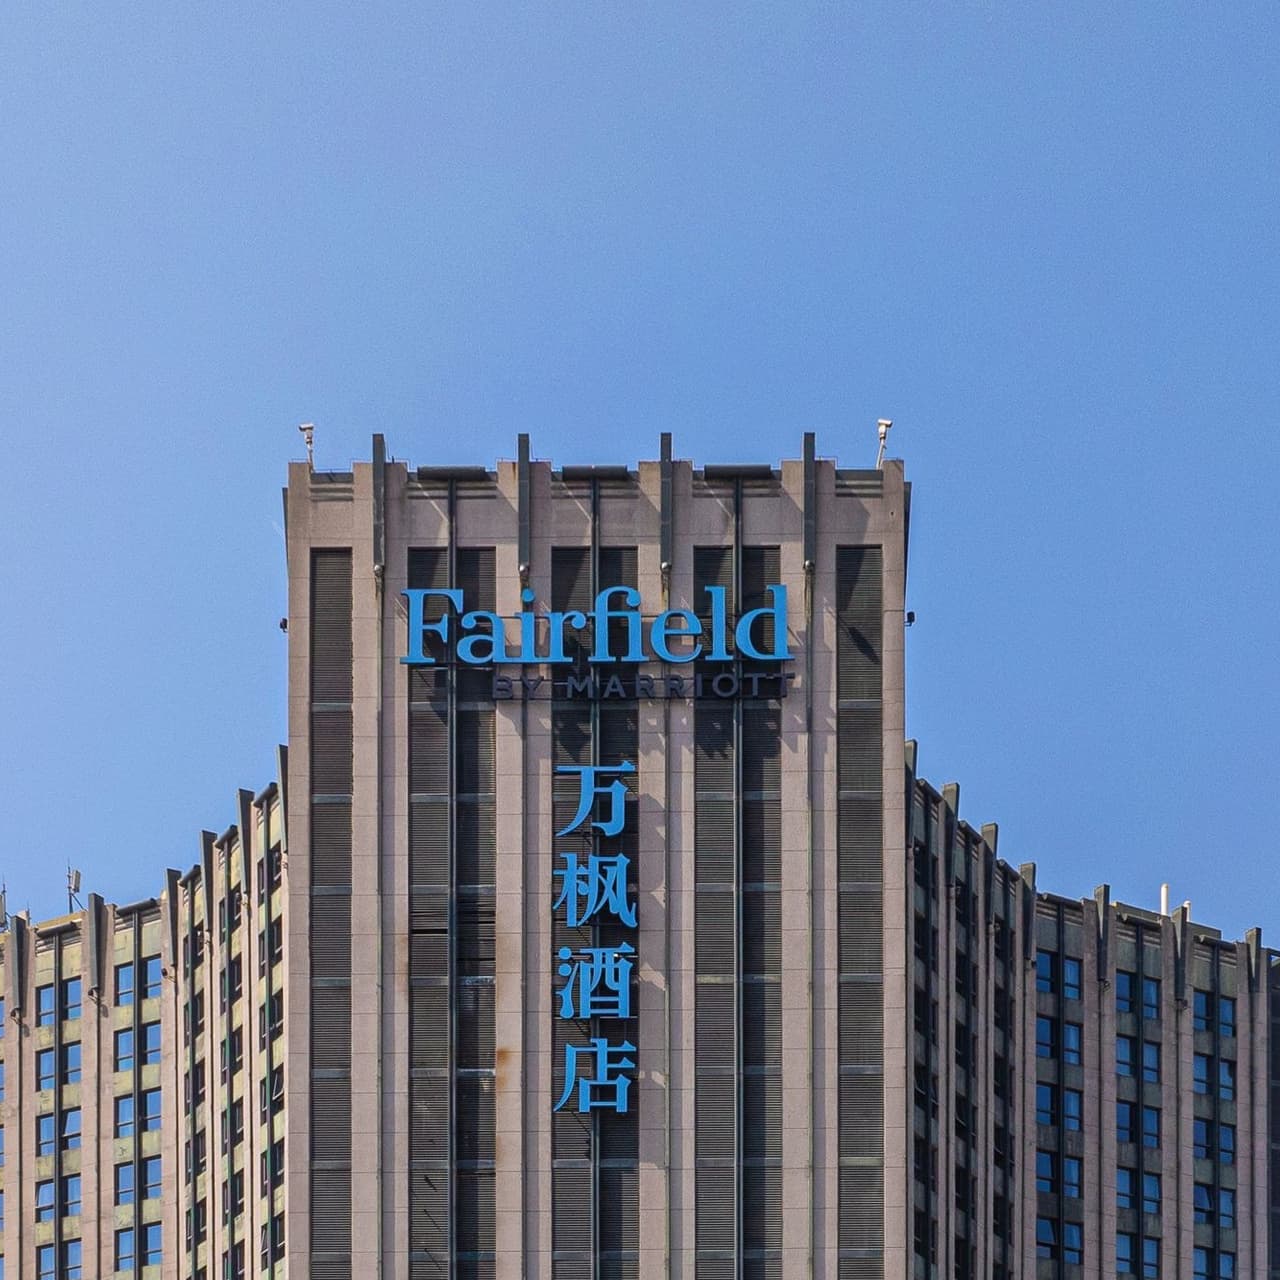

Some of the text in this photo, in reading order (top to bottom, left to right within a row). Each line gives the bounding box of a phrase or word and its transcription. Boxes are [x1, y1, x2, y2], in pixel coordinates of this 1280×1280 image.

[399, 584, 795, 665] Fairfield
[491, 672, 796, 700] BY MARRIOTT
[552, 760, 639, 1114] 万枫酒店
